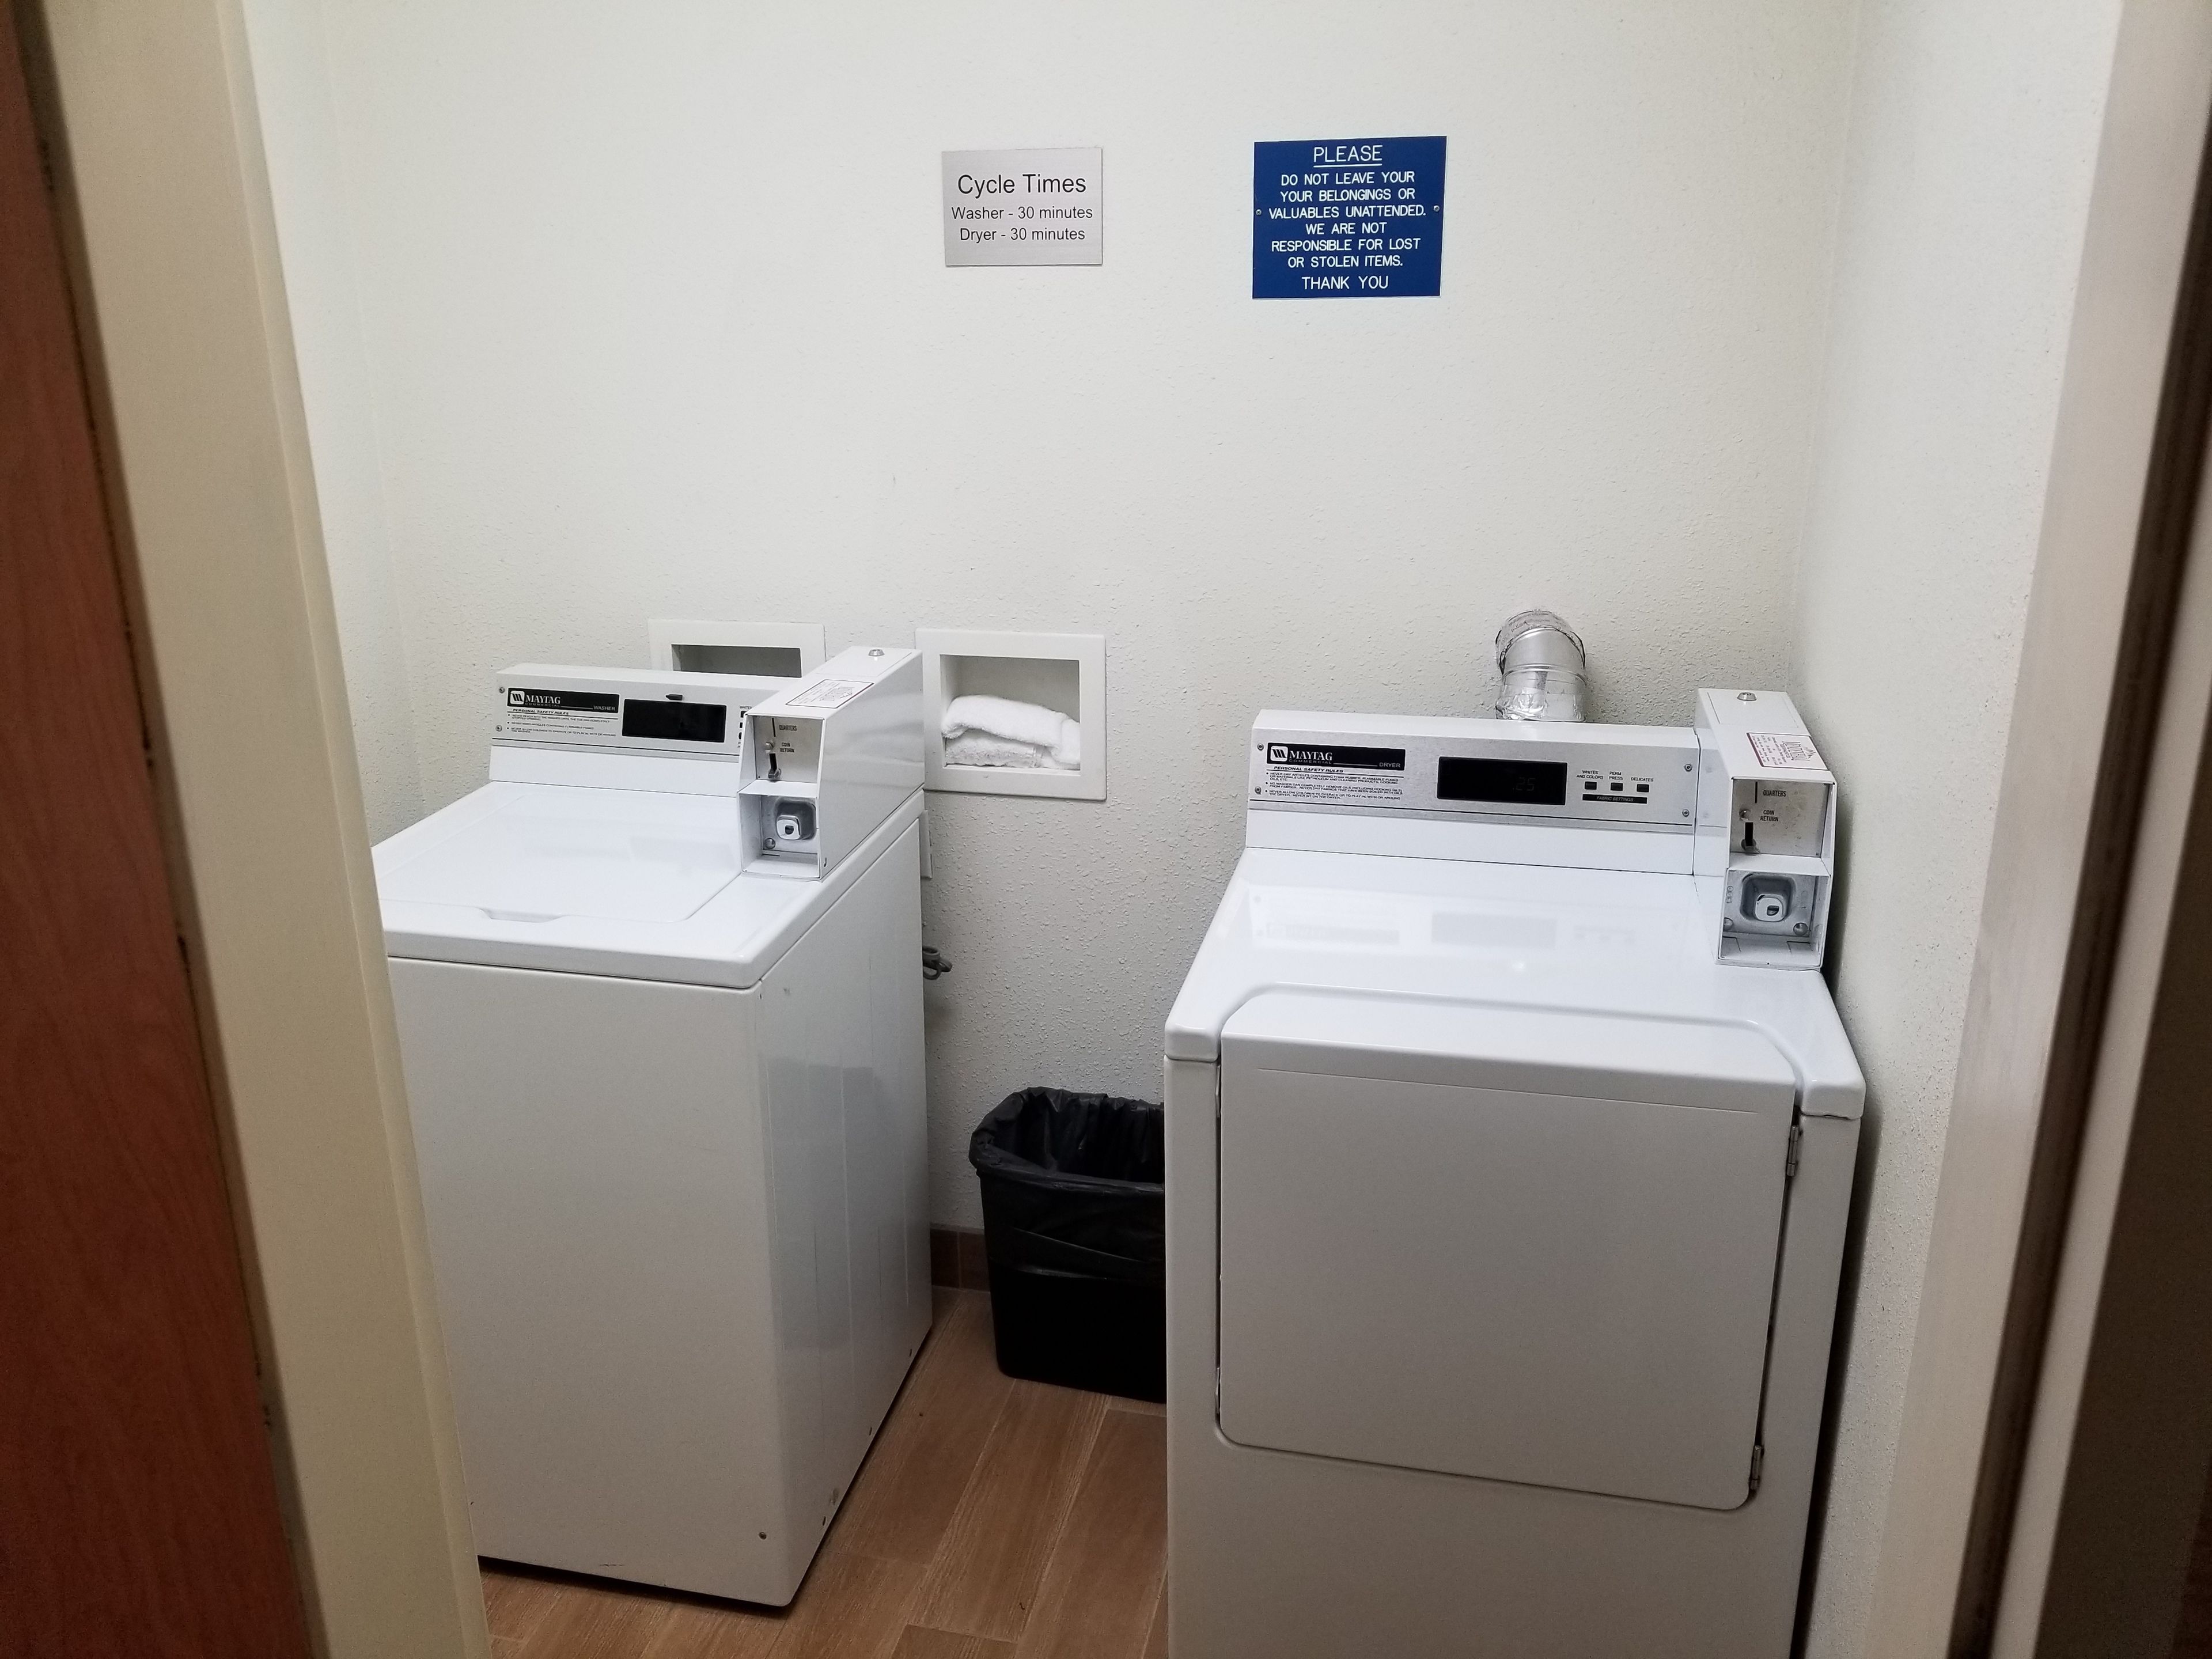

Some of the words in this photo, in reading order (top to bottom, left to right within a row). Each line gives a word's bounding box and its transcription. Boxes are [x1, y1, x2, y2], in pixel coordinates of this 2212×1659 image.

[1313, 145, 1383, 162] PLEASE
[957, 174, 1016, 199] Cycle
[1022, 173, 1086, 193] Times
[1281, 174, 1298, 186] DO
[1304, 173, 1330, 185] NOT
[1335, 172, 1375, 185] LEAVE
[1381, 171, 1415, 183] YOUR
[1280, 190, 1313, 202] YOUR
[1319, 189, 1391, 202] BELONGINGS
[1398, 188, 1415, 199] OR
[951, 206, 1004, 219] Washer
[1018, 206, 1035, 219] 30
[1039, 206, 1093, 219] minutes
[1268, 206, 1339, 219] VALUABLES
[1346, 204, 1426, 218] UNATTENDED.
[960, 228, 997, 244] Dryer
[1010, 228, 1027, 240] 30
[1032, 227, 1085, 240] minutes
[1306, 223, 1325, 235] WE
[1331, 222, 1355, 234] ARE
[1362, 222, 1387, 234] NOT
[1271, 239, 1352, 252] RESPONSIBLE
[1358, 238, 1382, 250] FOR
[1389, 237, 1421, 249] LOST
[1287, 256, 1304, 268] OR
[1310, 255, 1359, 267] STOLEN
[1365, 255, 1403, 267] ITEMS.
[1301, 275, 1350, 290] THANK
[1358, 275, 1389, 289] YOU
[525, 695, 561, 704] MAYTAG
[1289, 750, 1332, 760] MAYTAG
